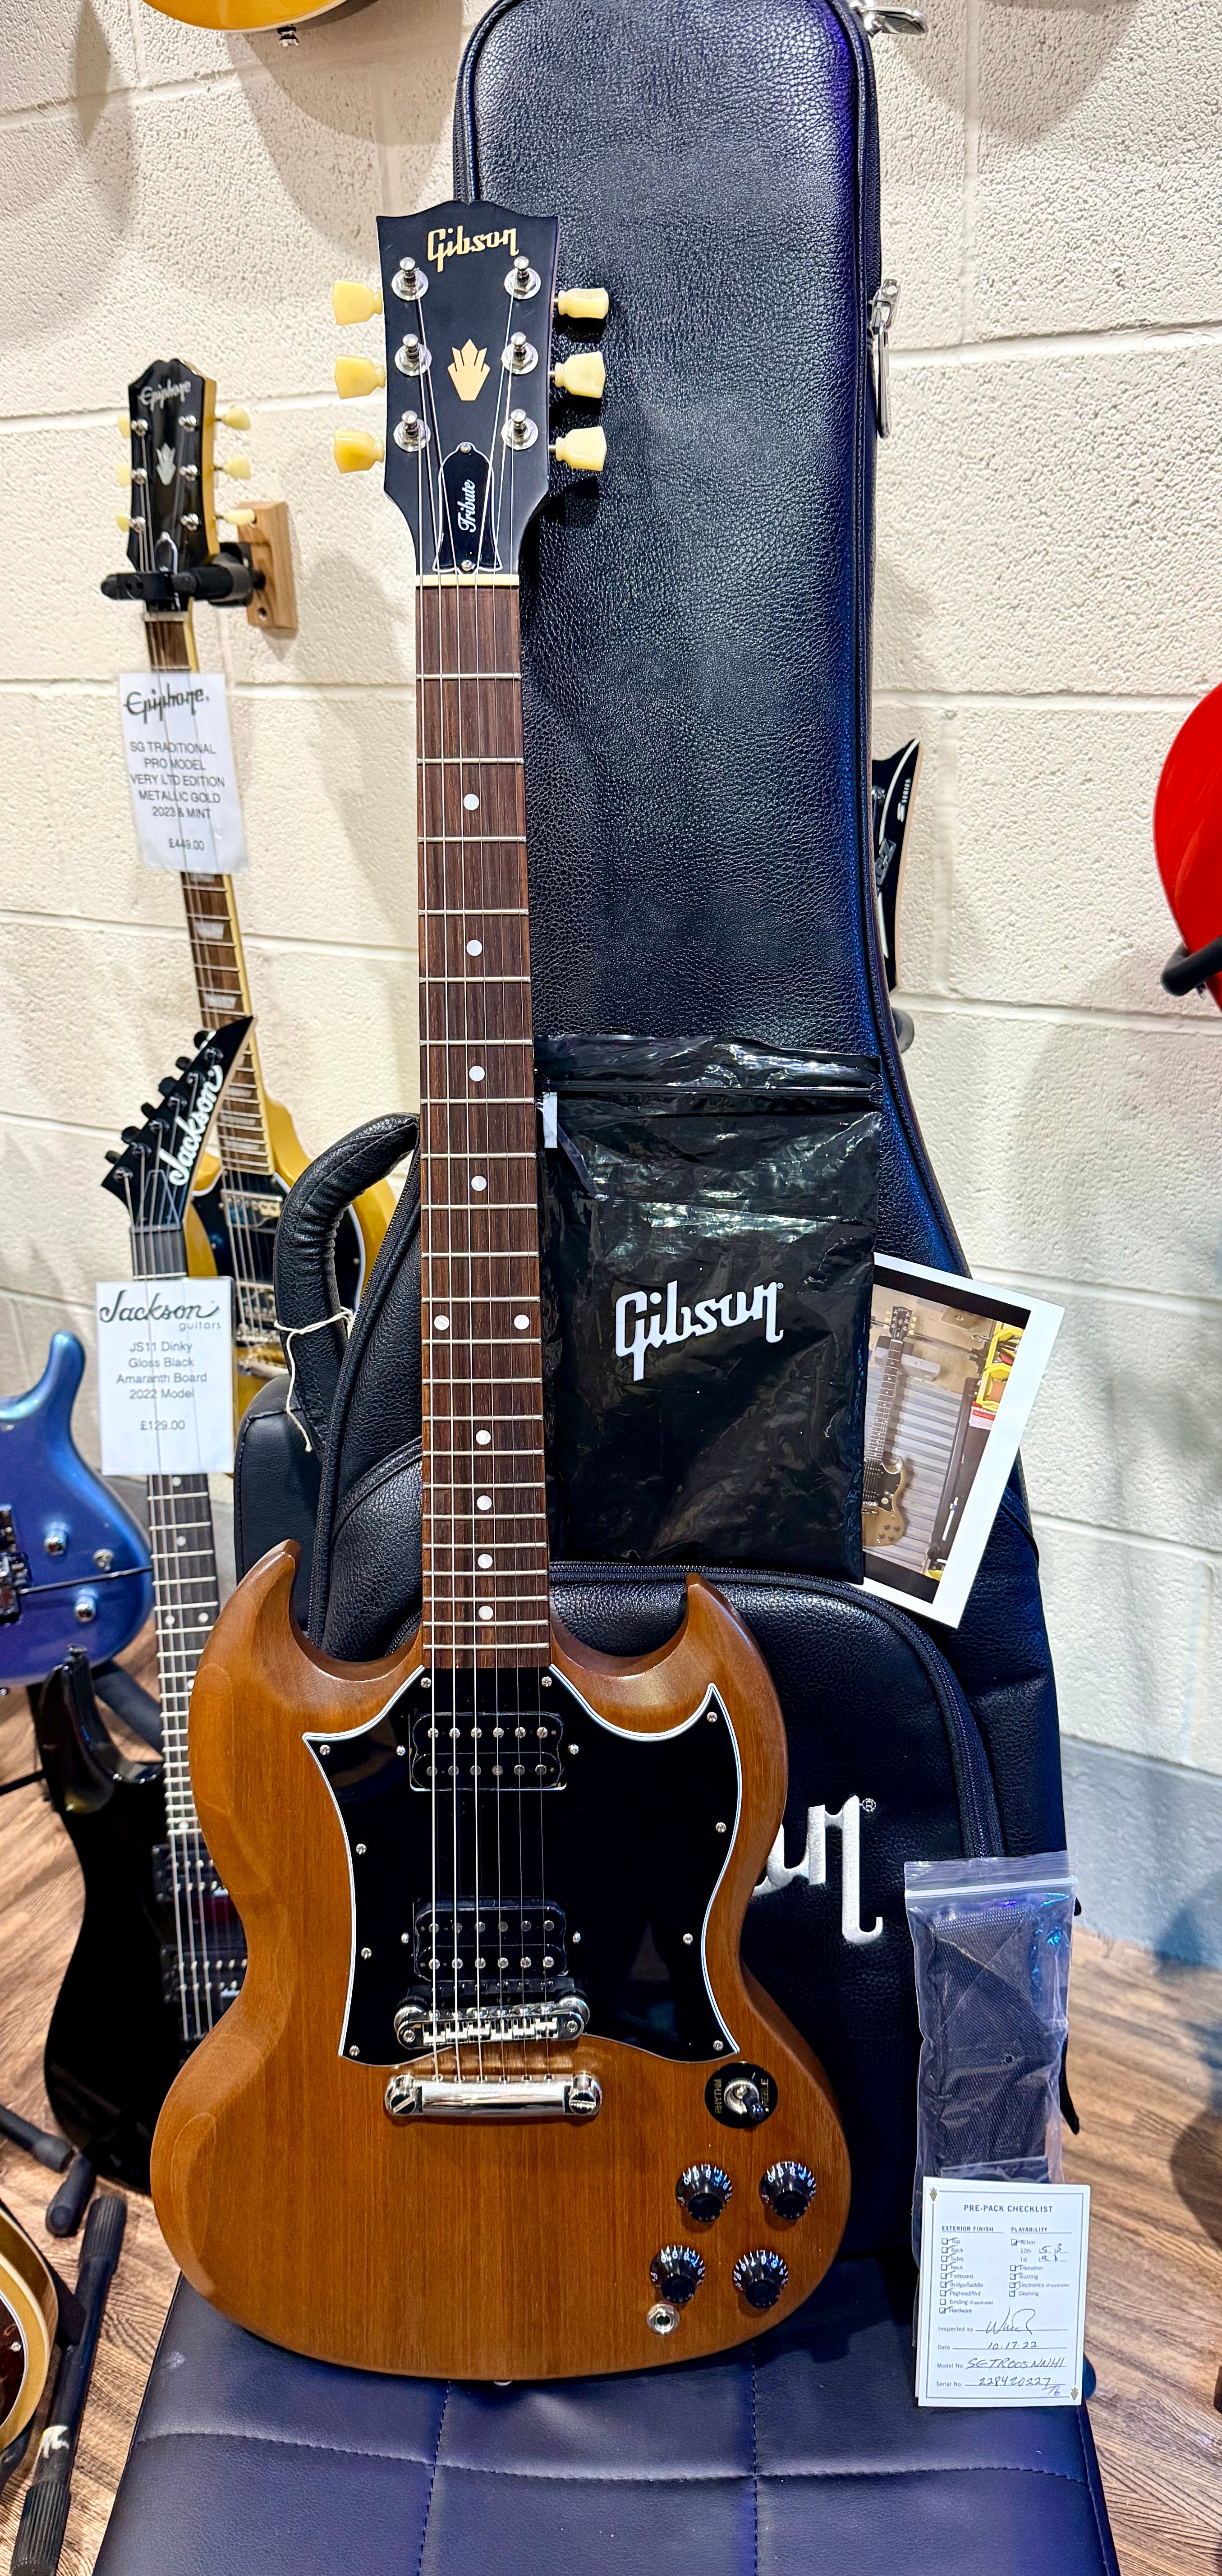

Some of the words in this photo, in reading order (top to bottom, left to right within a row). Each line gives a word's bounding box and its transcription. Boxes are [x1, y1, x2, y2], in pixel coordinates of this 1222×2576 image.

[427, 225, 519, 273] Gibson
[138, 378, 191, 412] Epiphone
[457, 479, 476, 533] Tribute
[130, 741, 145, 752] SG
[148, 741, 216, 754] TRADITIONAL
[144, 758, 167, 768] PRO
[171, 759, 206, 770] MODEL
[130, 774, 158, 784] VERY
[162, 774, 180, 785] LTD
[183, 776, 225, 787] EDITION
[138, 790, 188, 801] METALLIC
[191, 792, 221, 803] GOLD
[152, 806, 175, 817] 2023
[178, 808, 184, 817] &
[187, 808, 211, 819] MINT
[169, 838, 205, 850] £449.00
[159, 1065, 223, 1186] Jackson
[100, 1289, 220, 1323] Jackson
[179, 1321, 221, 1331] guitars
[616, 1280, 784, 1381] Gibson
[129, 1342, 156, 1352] JS11
[161, 1341, 193, 1353] Dinky
[129, 1357, 160, 1367] Gloss
[164, 1357, 194, 1367] Black
[116, 1374, 170, 1383] Amaranth
[174, 1373, 207, 1382] Board
[129, 1389, 156, 1399] 2022
[161, 1388, 194, 1398] Model
[140, 1420, 185, 1431] £129.00
